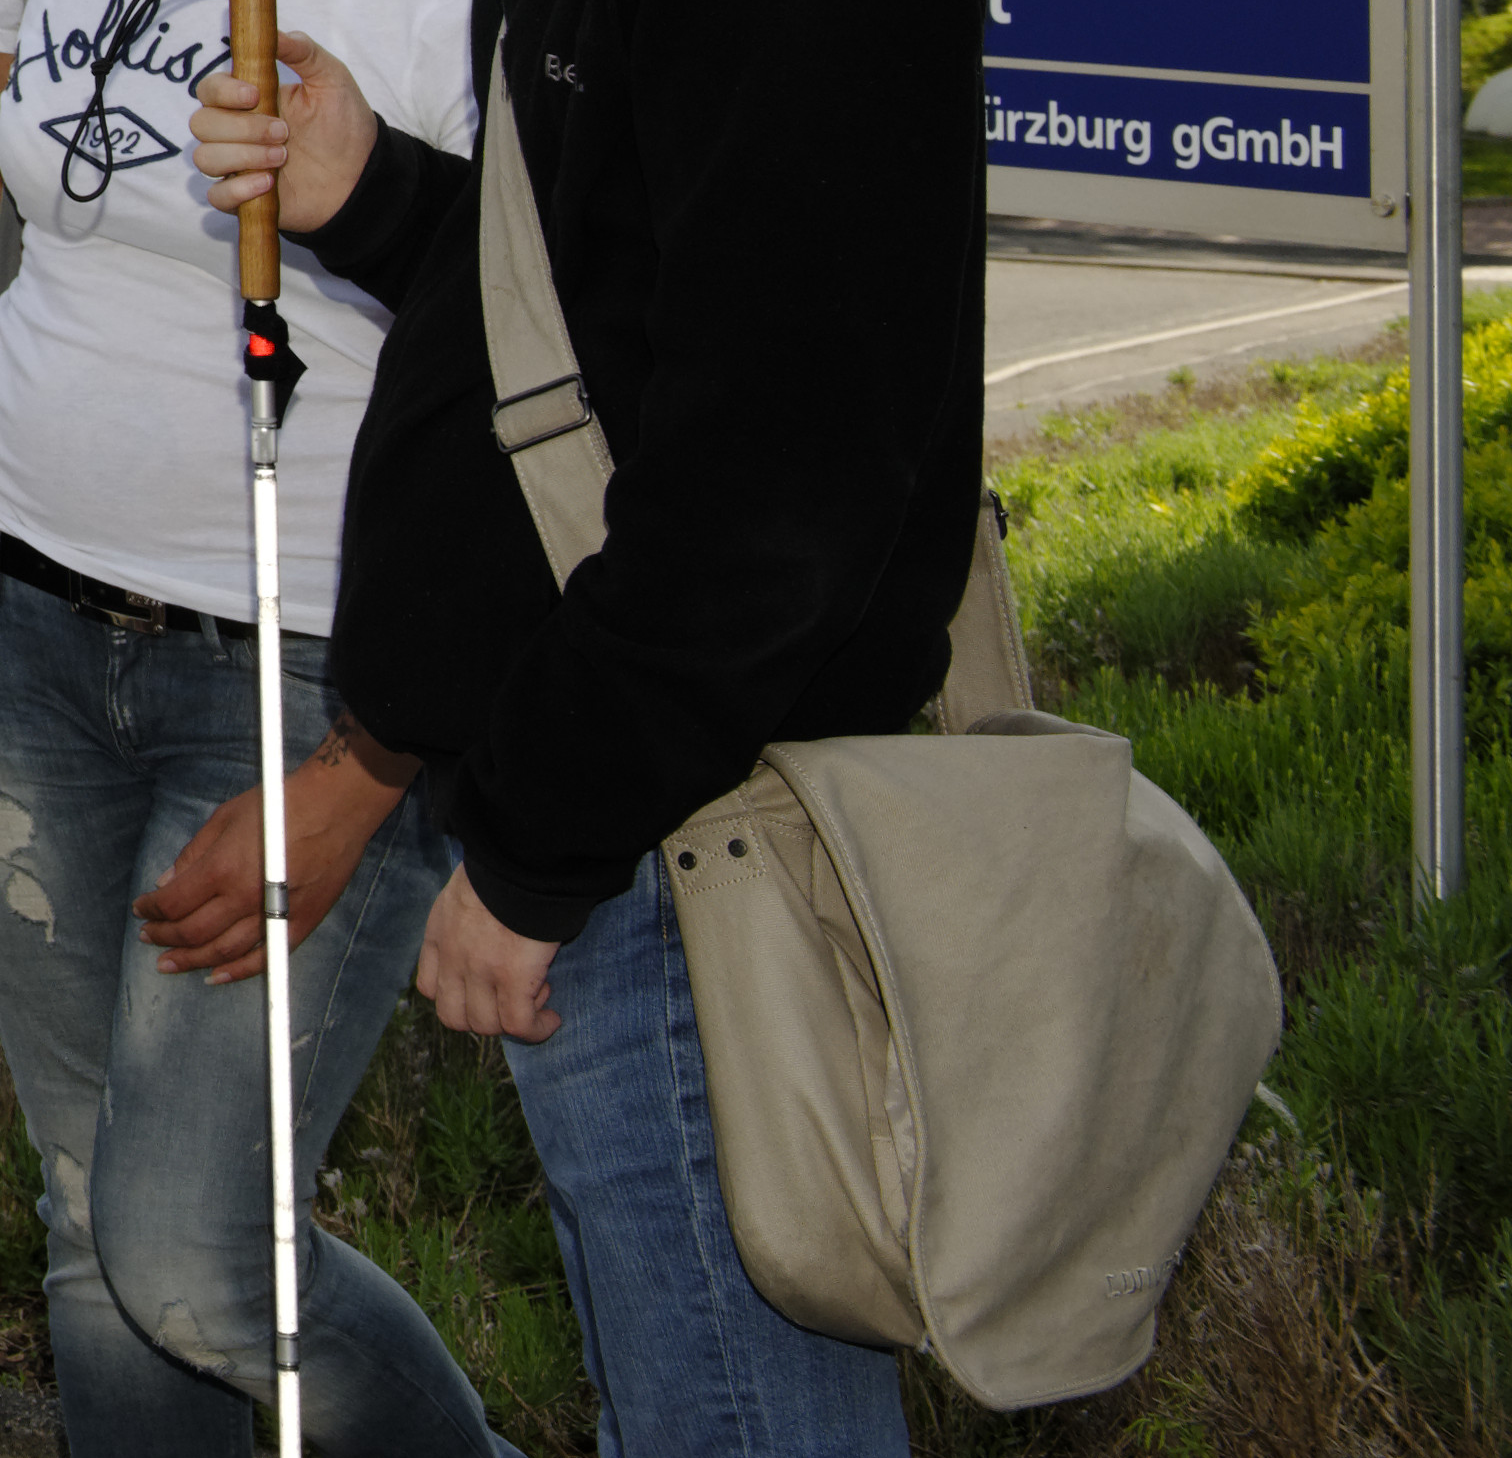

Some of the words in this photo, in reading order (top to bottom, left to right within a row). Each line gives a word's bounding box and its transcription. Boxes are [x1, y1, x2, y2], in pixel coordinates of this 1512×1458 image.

[79, 120, 141, 154] 1922
[984, 94, 1152, 166] ürzburg
[1172, 115, 1344, 170] gGmbH
